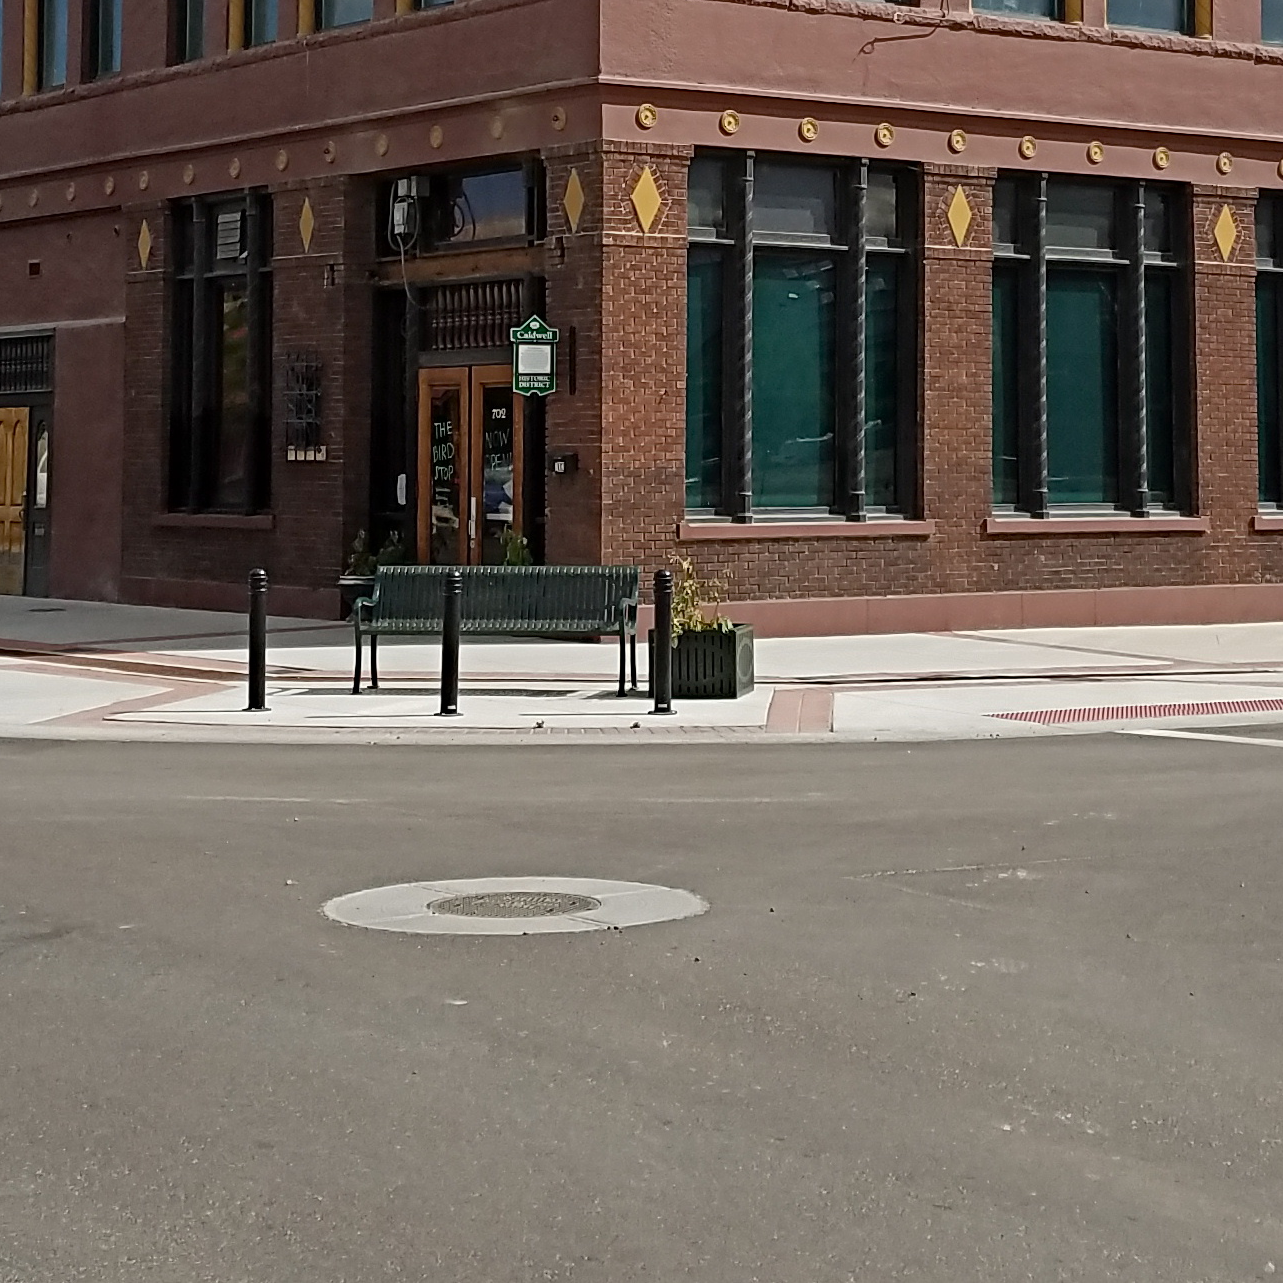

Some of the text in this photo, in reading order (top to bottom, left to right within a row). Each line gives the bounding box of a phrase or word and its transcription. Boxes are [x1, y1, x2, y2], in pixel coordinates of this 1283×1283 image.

[517, 330, 553, 340] Caldwell
[492, 408, 506, 419] 702
[434, 421, 453, 440] THE
[485, 429, 510, 449] NOW
[433, 442, 455, 463] BIRD
[434, 465, 454, 481] STOP
